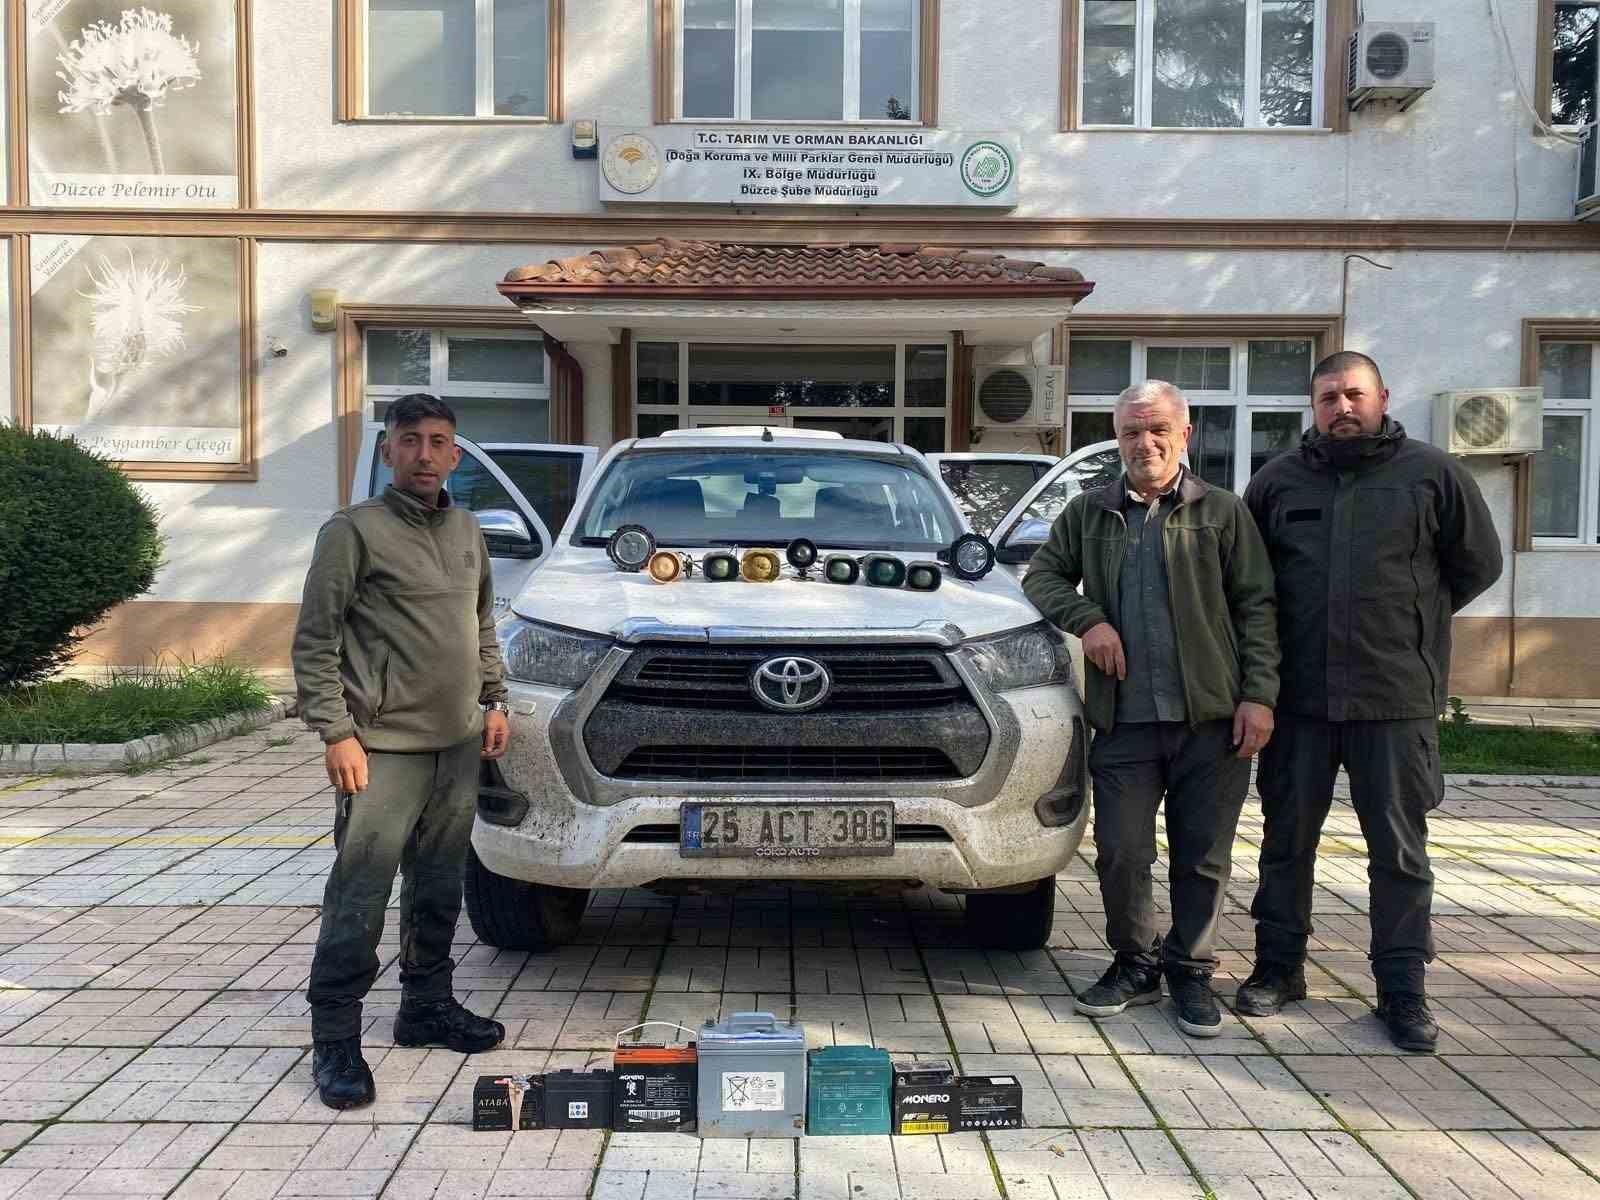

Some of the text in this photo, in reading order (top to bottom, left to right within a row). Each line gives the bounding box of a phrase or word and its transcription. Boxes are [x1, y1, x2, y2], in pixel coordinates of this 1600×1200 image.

[698, 132, 923, 146] T.C. TARIM VE ORMAN BAKANLIĞI
[704, 151, 751, 162] Koruma
[755, 154, 768, 162] ve
[772, 152, 797, 163] Milli
[801, 153, 844, 164] Parklar
[847, 153, 883, 164] Genel
[886, 153, 953, 167] Müdürlüğü)
[743, 168, 876, 182] IX. Bölge Müdürlüğü
[51, 181, 217, 199] Düzce Pelemir Otu
[741, 185, 878, 199] Düzce Şube Müdürlüğü
[93, 434, 179, 454] Peygamber
[703, 810, 887, 844] 25 ACT 386
[788, 847, 820, 857] AUTO
[902, 1094, 950, 1104] MONERO
